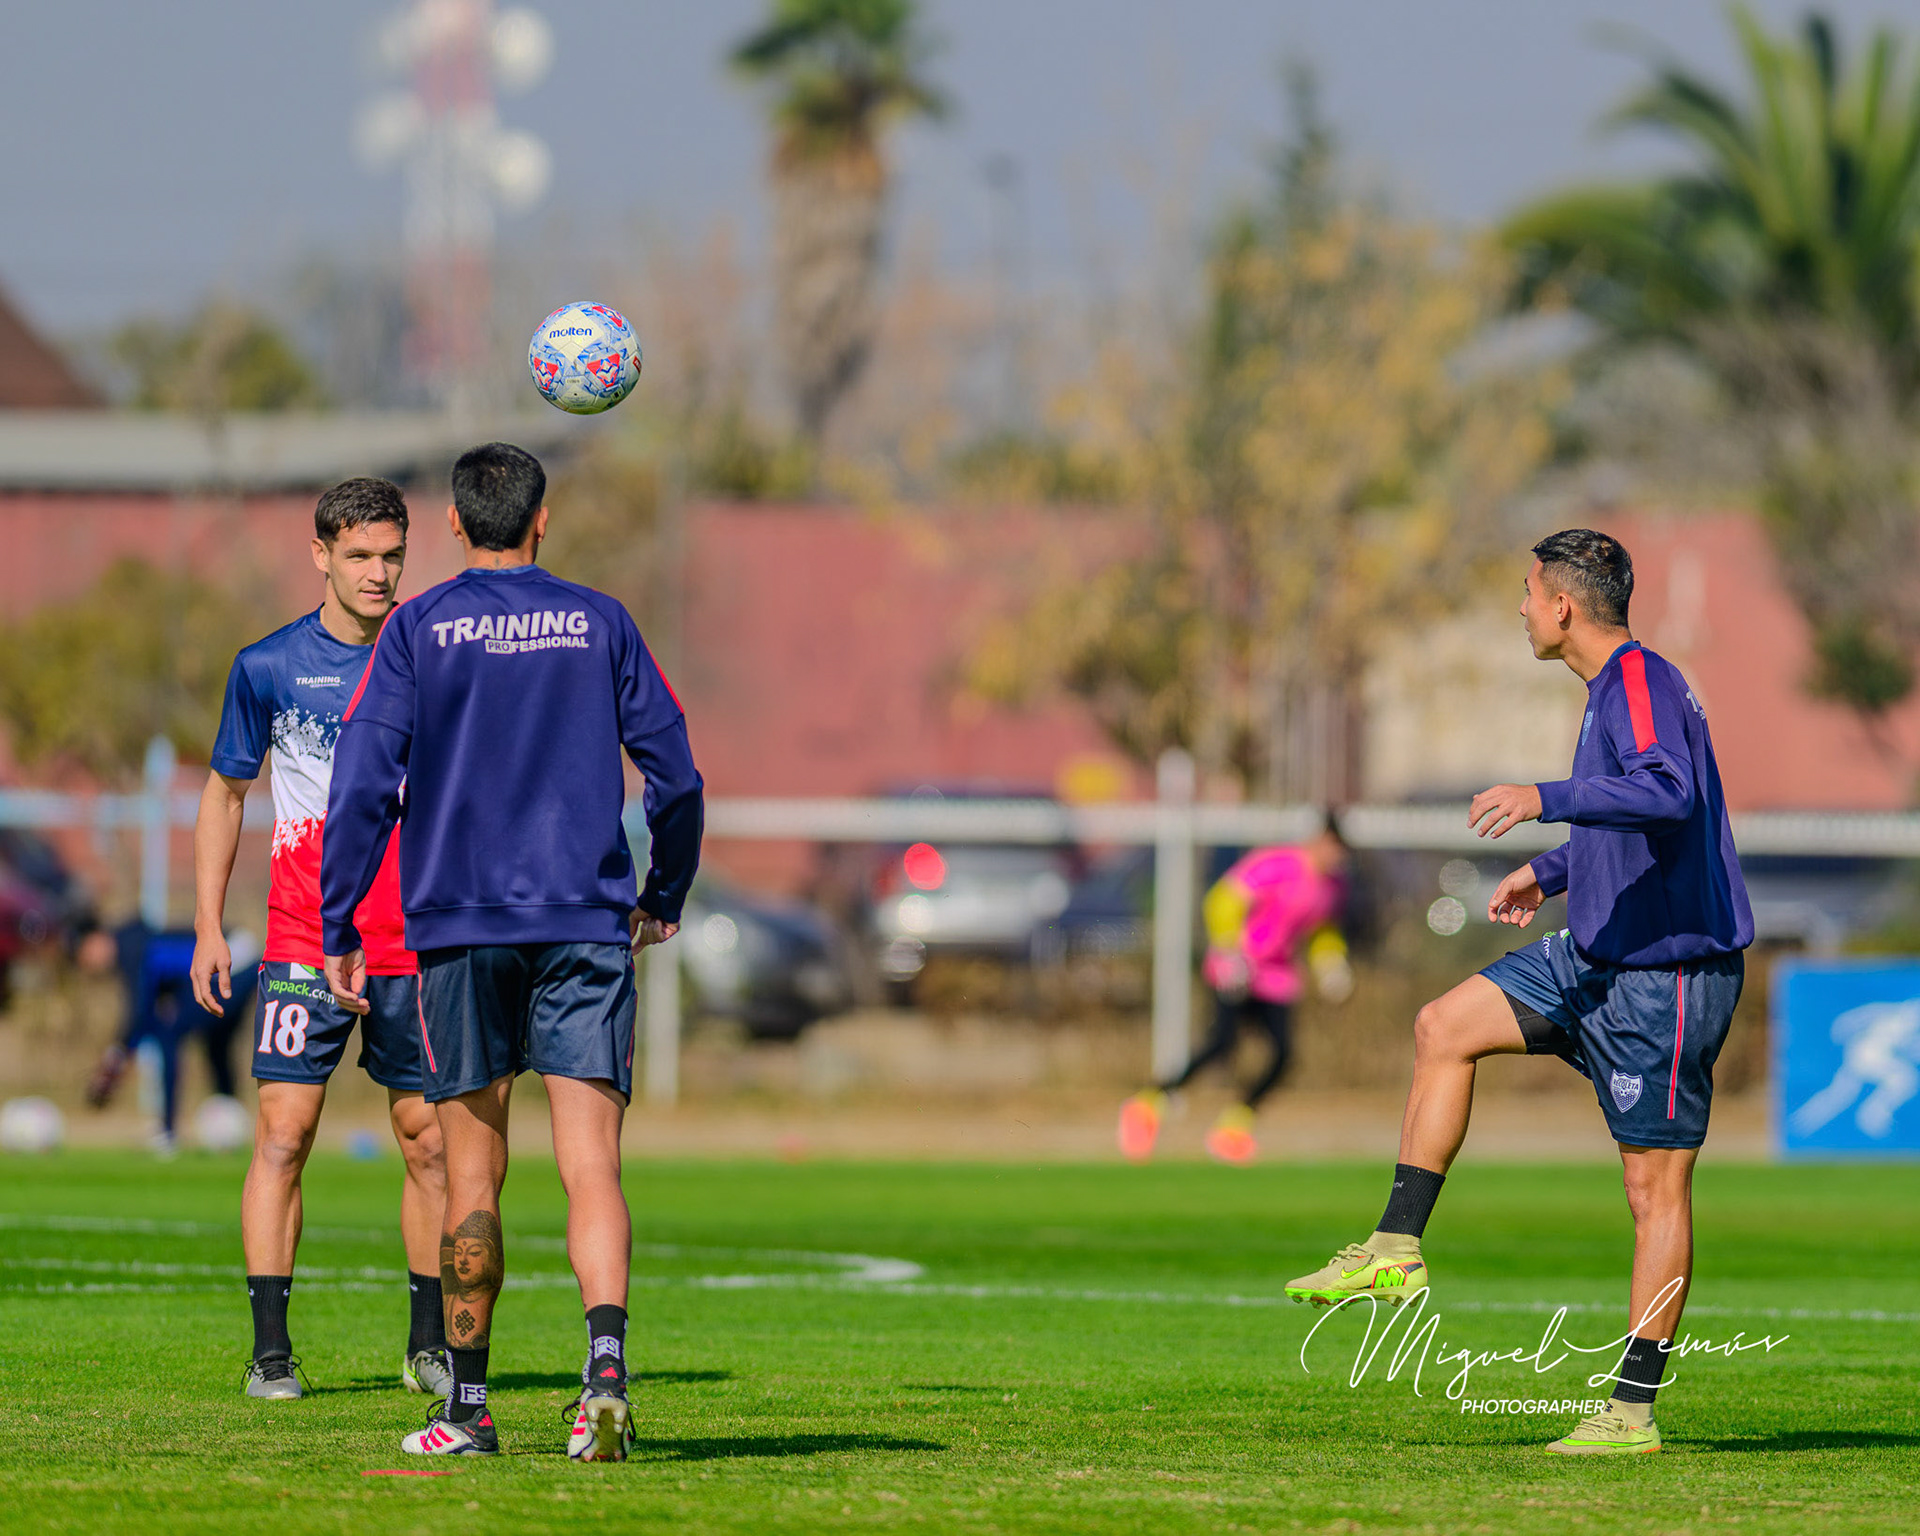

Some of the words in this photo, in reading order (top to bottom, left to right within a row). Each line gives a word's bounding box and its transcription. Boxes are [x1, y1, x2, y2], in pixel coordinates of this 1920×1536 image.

[549, 327, 592, 338] molten
[432, 611, 589, 648] TRAINING
[485, 636, 589, 654] PROFESSIONAL
[295, 676, 341, 686] TRAINING
[267, 979, 335, 1005] yapack.com
[258, 999, 310, 1057] 18
[596, 1337, 618, 1356] FS
[463, 1386, 487, 1402] FS
